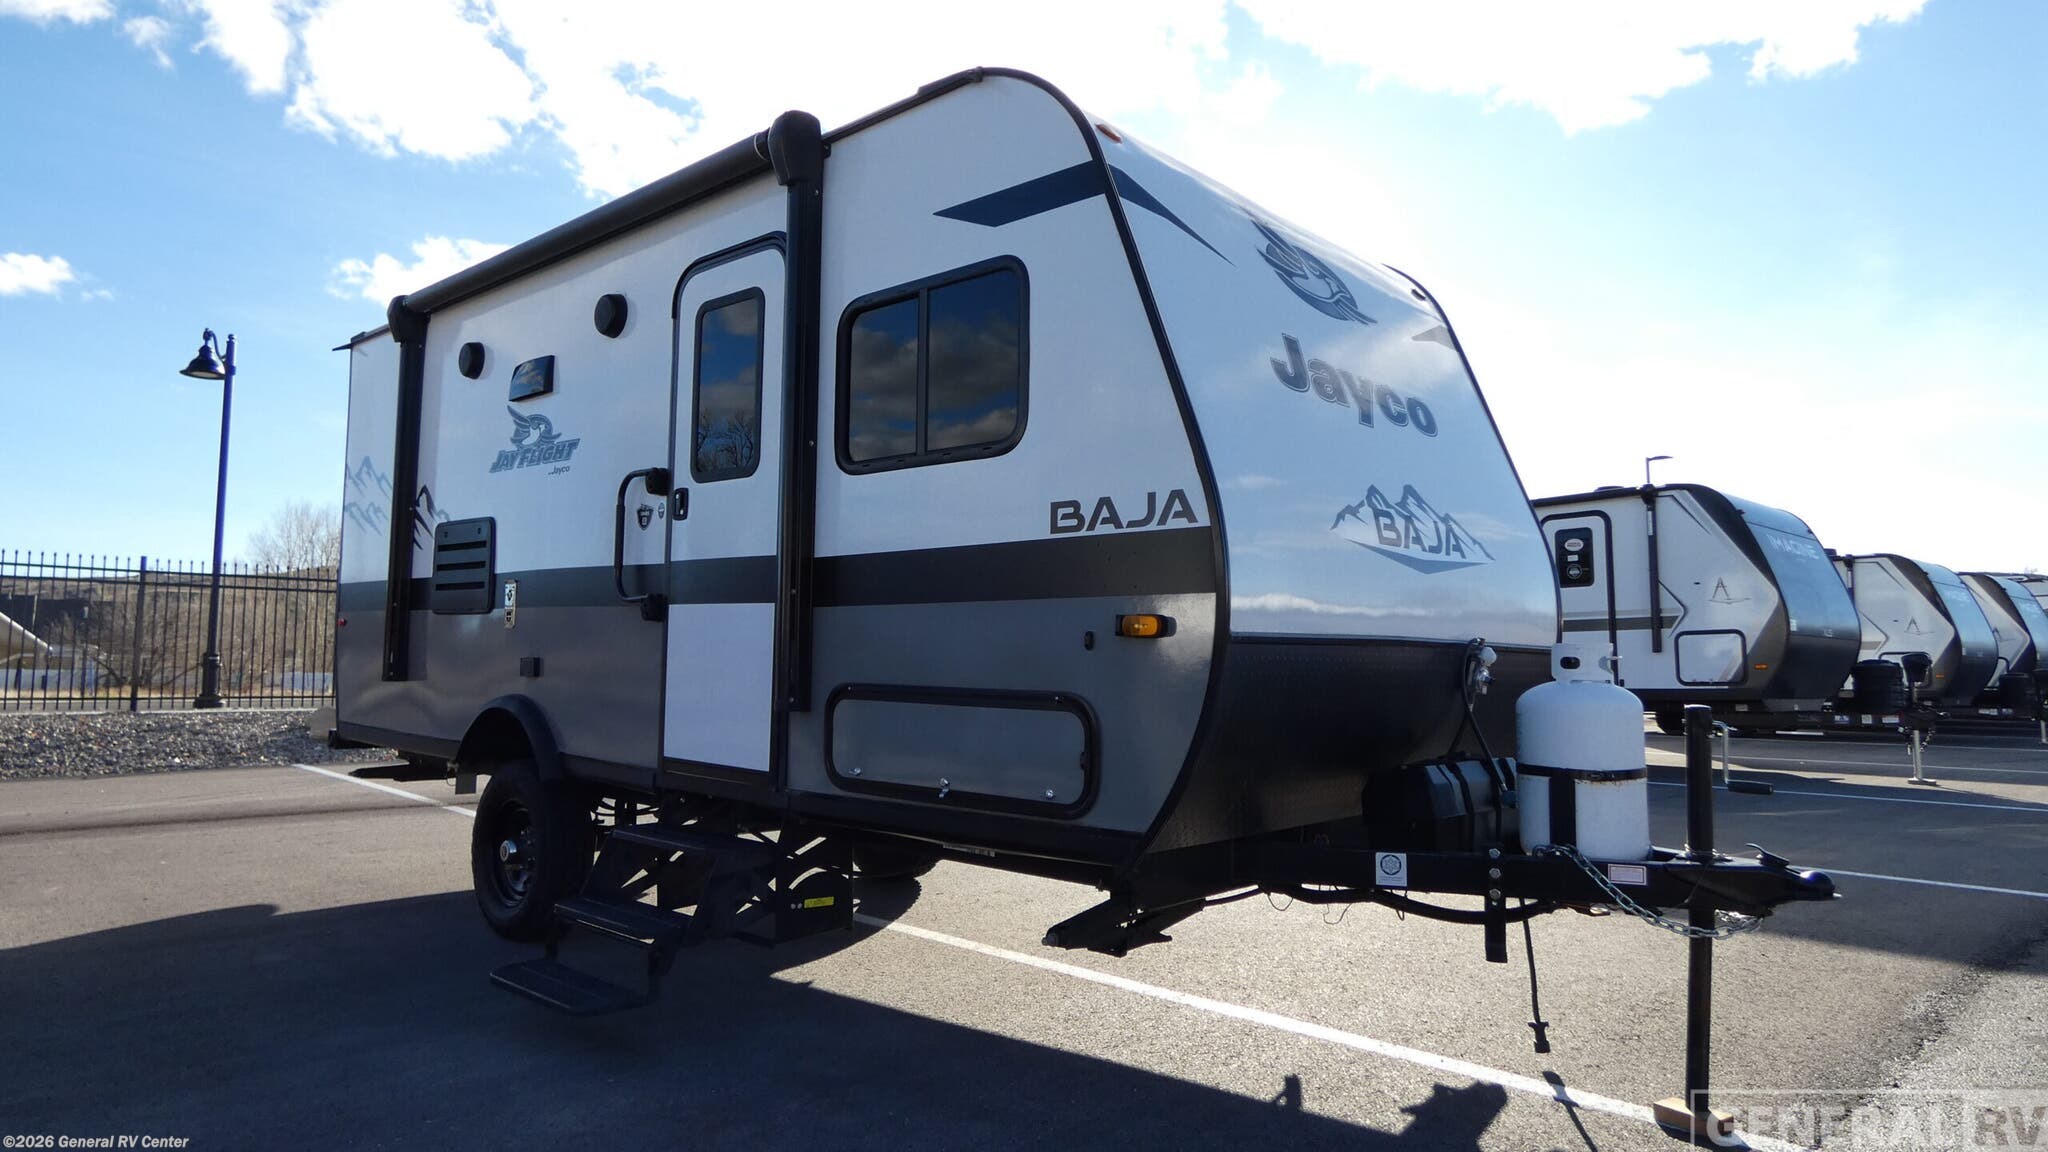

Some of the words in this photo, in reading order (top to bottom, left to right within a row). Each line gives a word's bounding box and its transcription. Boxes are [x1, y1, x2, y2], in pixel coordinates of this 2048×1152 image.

[1270, 333, 1439, 437] Jayco
[1050, 488, 1199, 534] BAJA
[1376, 508, 1467, 559] BAJA
